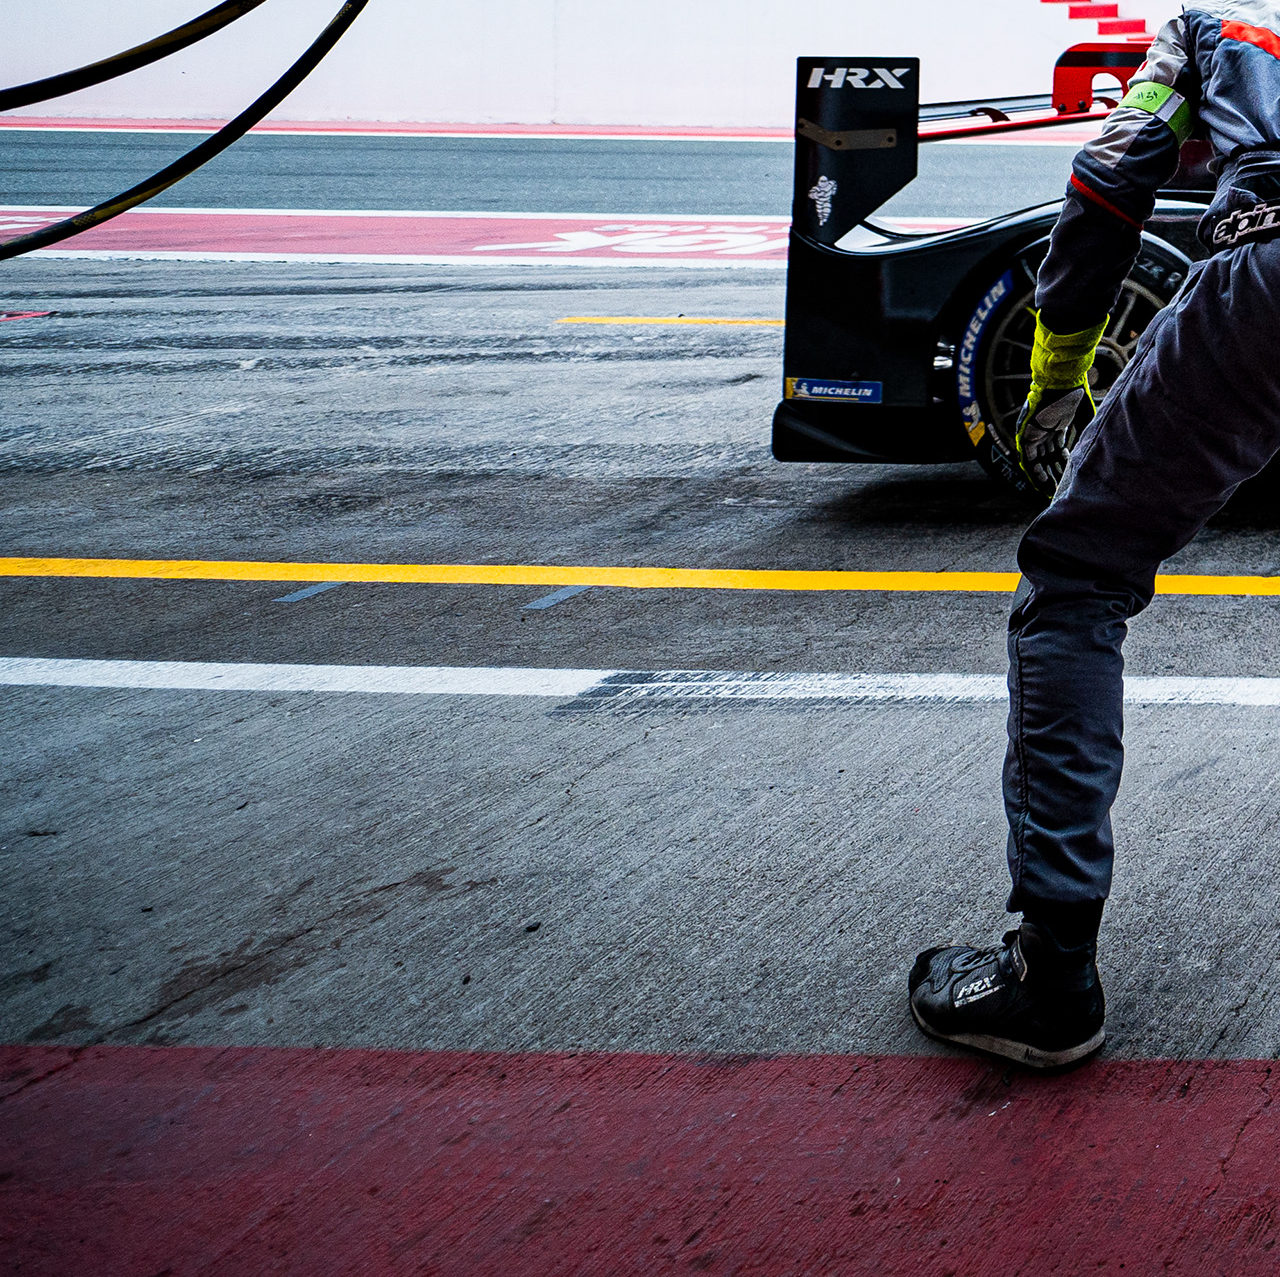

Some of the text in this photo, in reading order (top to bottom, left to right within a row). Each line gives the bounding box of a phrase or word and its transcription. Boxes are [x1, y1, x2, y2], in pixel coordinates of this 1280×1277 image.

[806, 67, 911, 89] HRX
[957, 279, 1007, 399] MICHELIN
[811, 386, 874, 397] MICHELIN
